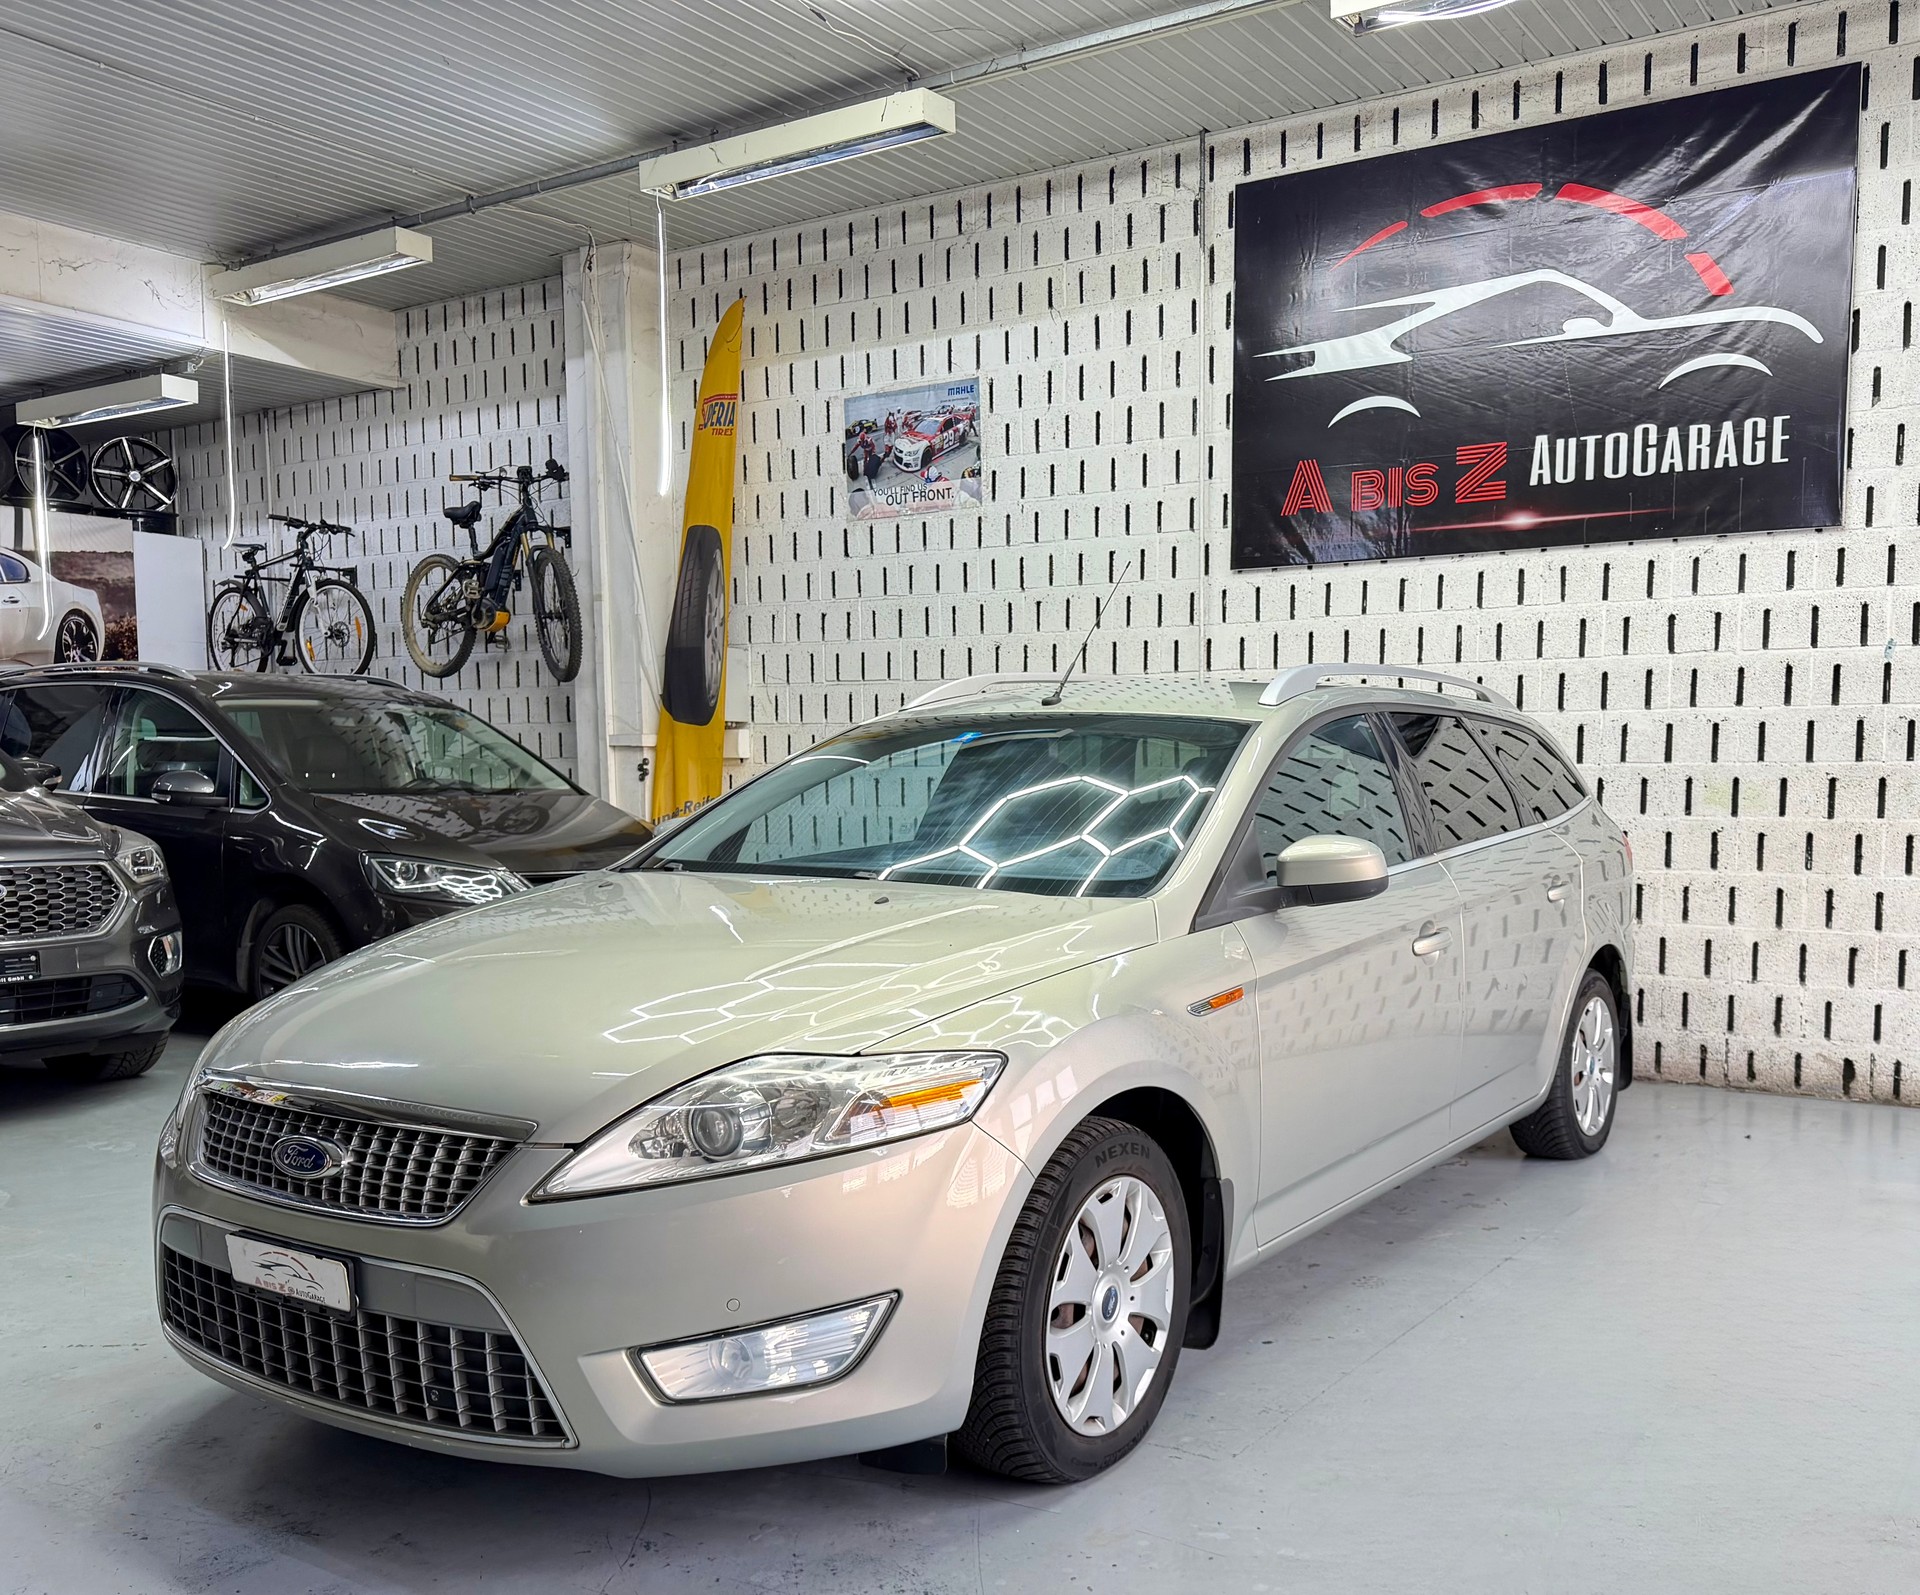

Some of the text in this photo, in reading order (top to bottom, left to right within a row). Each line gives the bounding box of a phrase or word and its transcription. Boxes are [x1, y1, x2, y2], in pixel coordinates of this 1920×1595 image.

[947, 384, 975, 396] MAHLE
[711, 428, 734, 436] TIRES
[1280, 459, 1334, 516] A
[1454, 441, 1508, 503] Z
[873, 482, 928, 497] YOU'LL FIND US
[885, 487, 955, 506] OUT FRONT.
[283, 1144, 316, 1169] Ford
[1095, 1142, 1150, 1168] NEXEN
